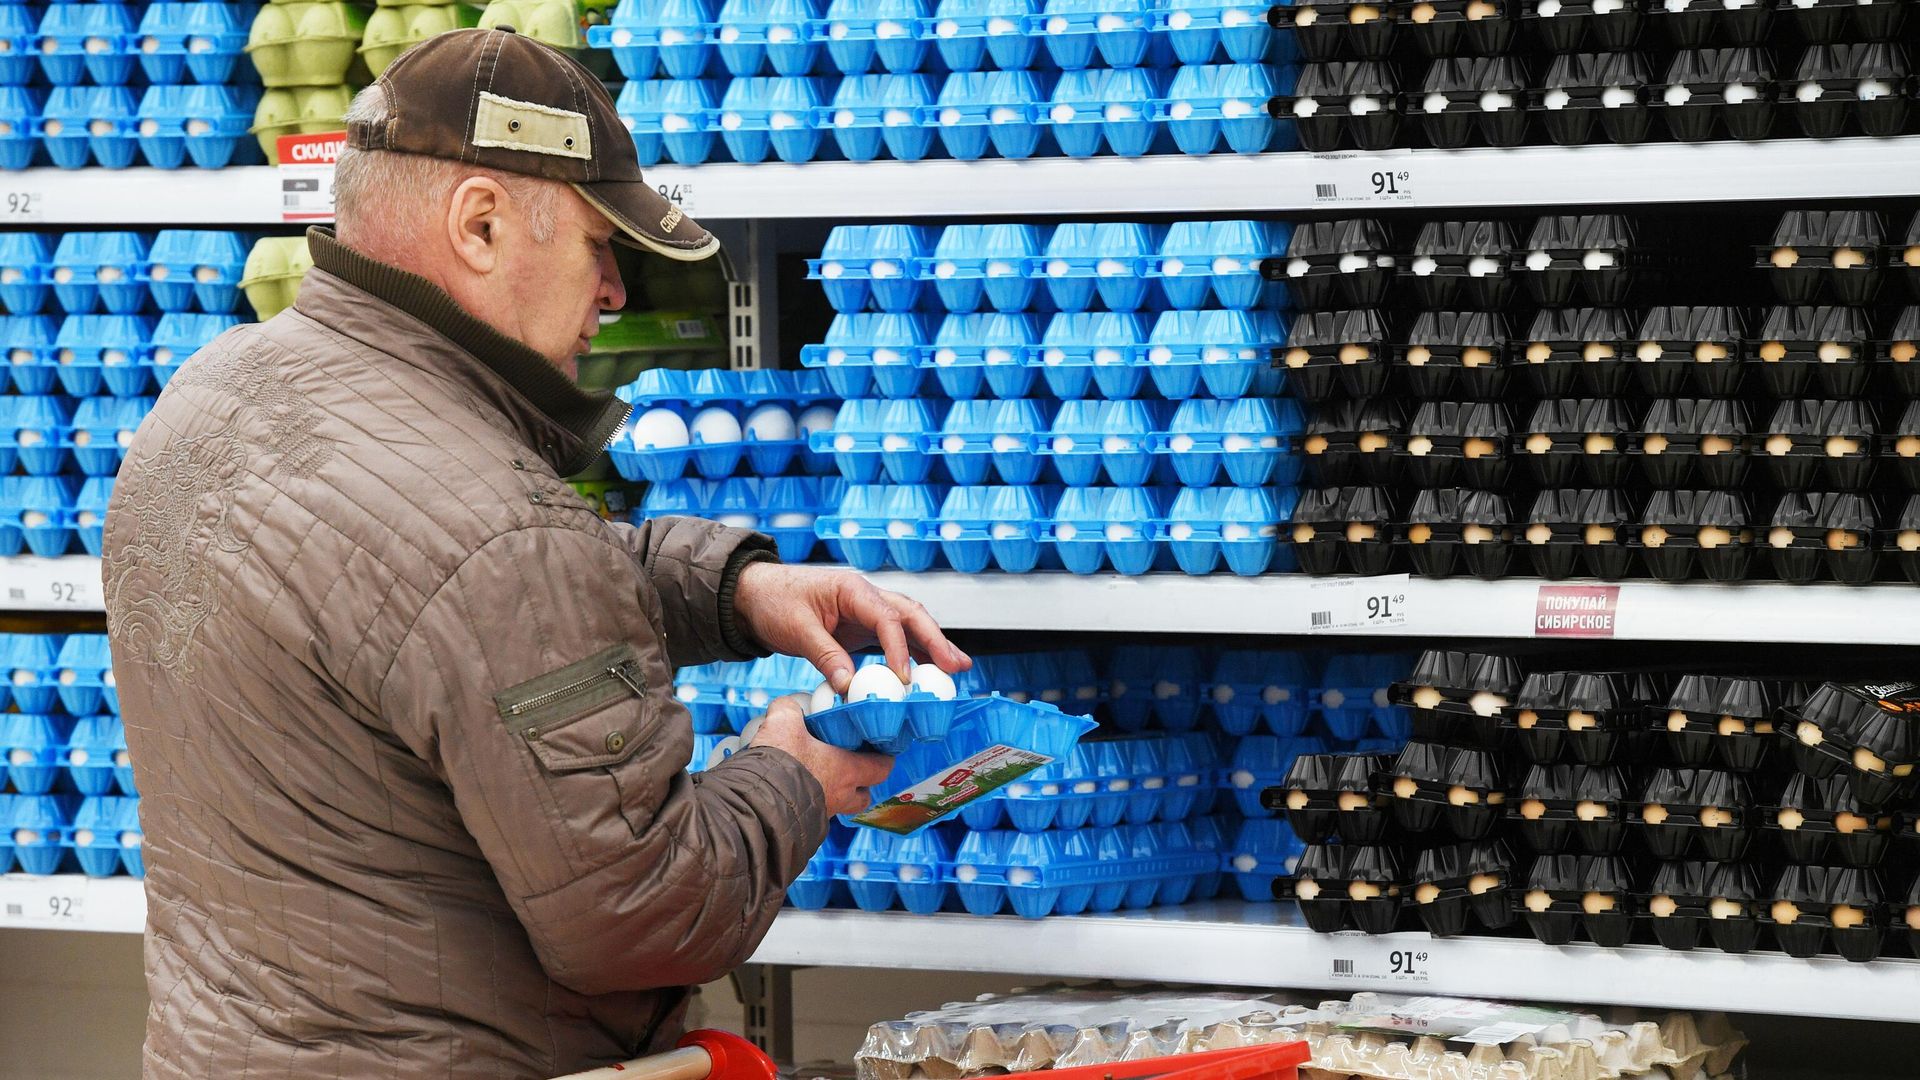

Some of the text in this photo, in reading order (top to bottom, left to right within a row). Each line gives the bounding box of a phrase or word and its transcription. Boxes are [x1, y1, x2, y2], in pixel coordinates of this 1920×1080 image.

[292, 141, 346, 162] СКИДК
[1371, 171, 1410, 194] 91 49
[8, 192, 31, 213] 92
[658, 184, 683, 205] 84
[51, 582, 76, 602] 92
[1545, 594, 1607, 610] ПОКУПАЙ
[1367, 594, 1405, 619] 91 49
[1537, 614, 1612, 629] СИБИРСКОЕ
[49, 896, 73, 917] 92
[1389, 951, 1428, 974] 91 49
